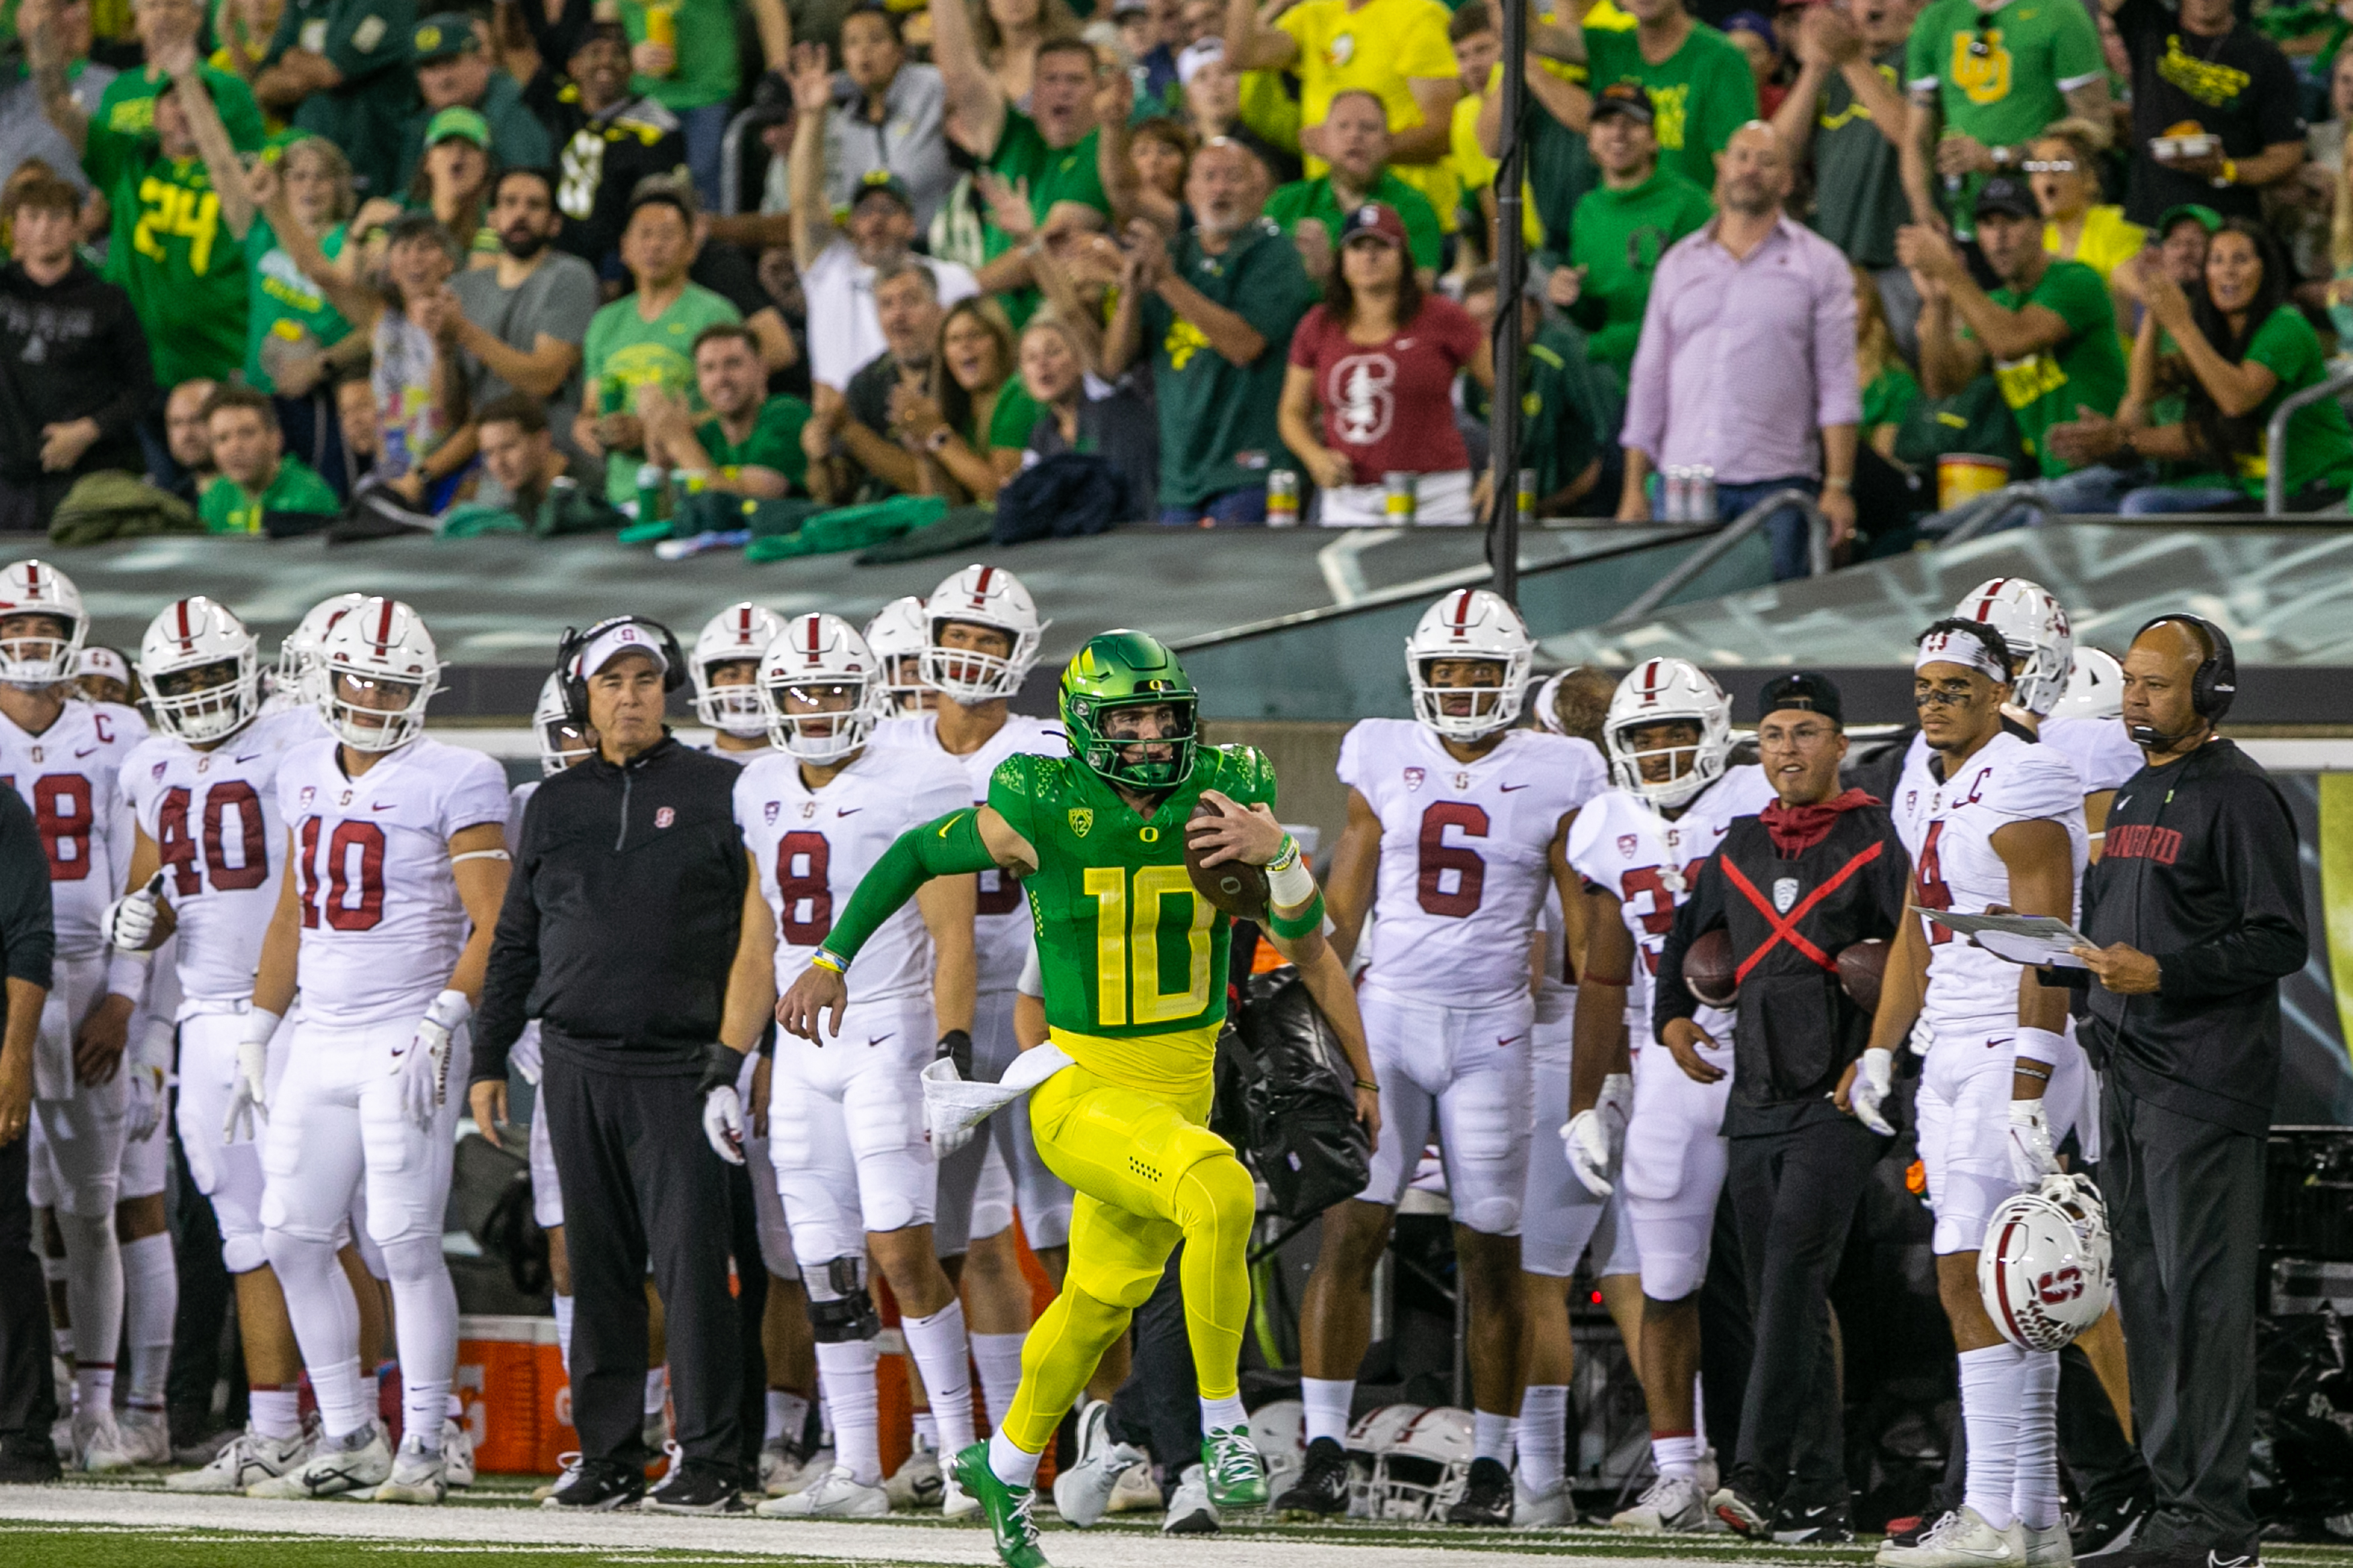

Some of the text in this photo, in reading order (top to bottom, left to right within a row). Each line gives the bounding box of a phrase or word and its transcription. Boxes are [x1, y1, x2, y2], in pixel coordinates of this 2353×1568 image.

[134, 176, 219, 277] 24
[1328, 352, 1397, 446] S
[94, 714, 114, 743] C
[1149, 679, 1162, 690] O
[1076, 820, 1088, 833] 12
[1968, 768, 1993, 804] C
[159, 780, 269, 897] 40
[302, 816, 385, 931] 10
[1140, 827, 1158, 842] O
[1417, 800, 1490, 919] 6
[776, 831, 832, 946] 8
[1220, 876, 1242, 895] O
[1917, 821, 1956, 945] 4
[1084, 865, 1215, 1025] 10
[2037, 1266, 2083, 1306] S
